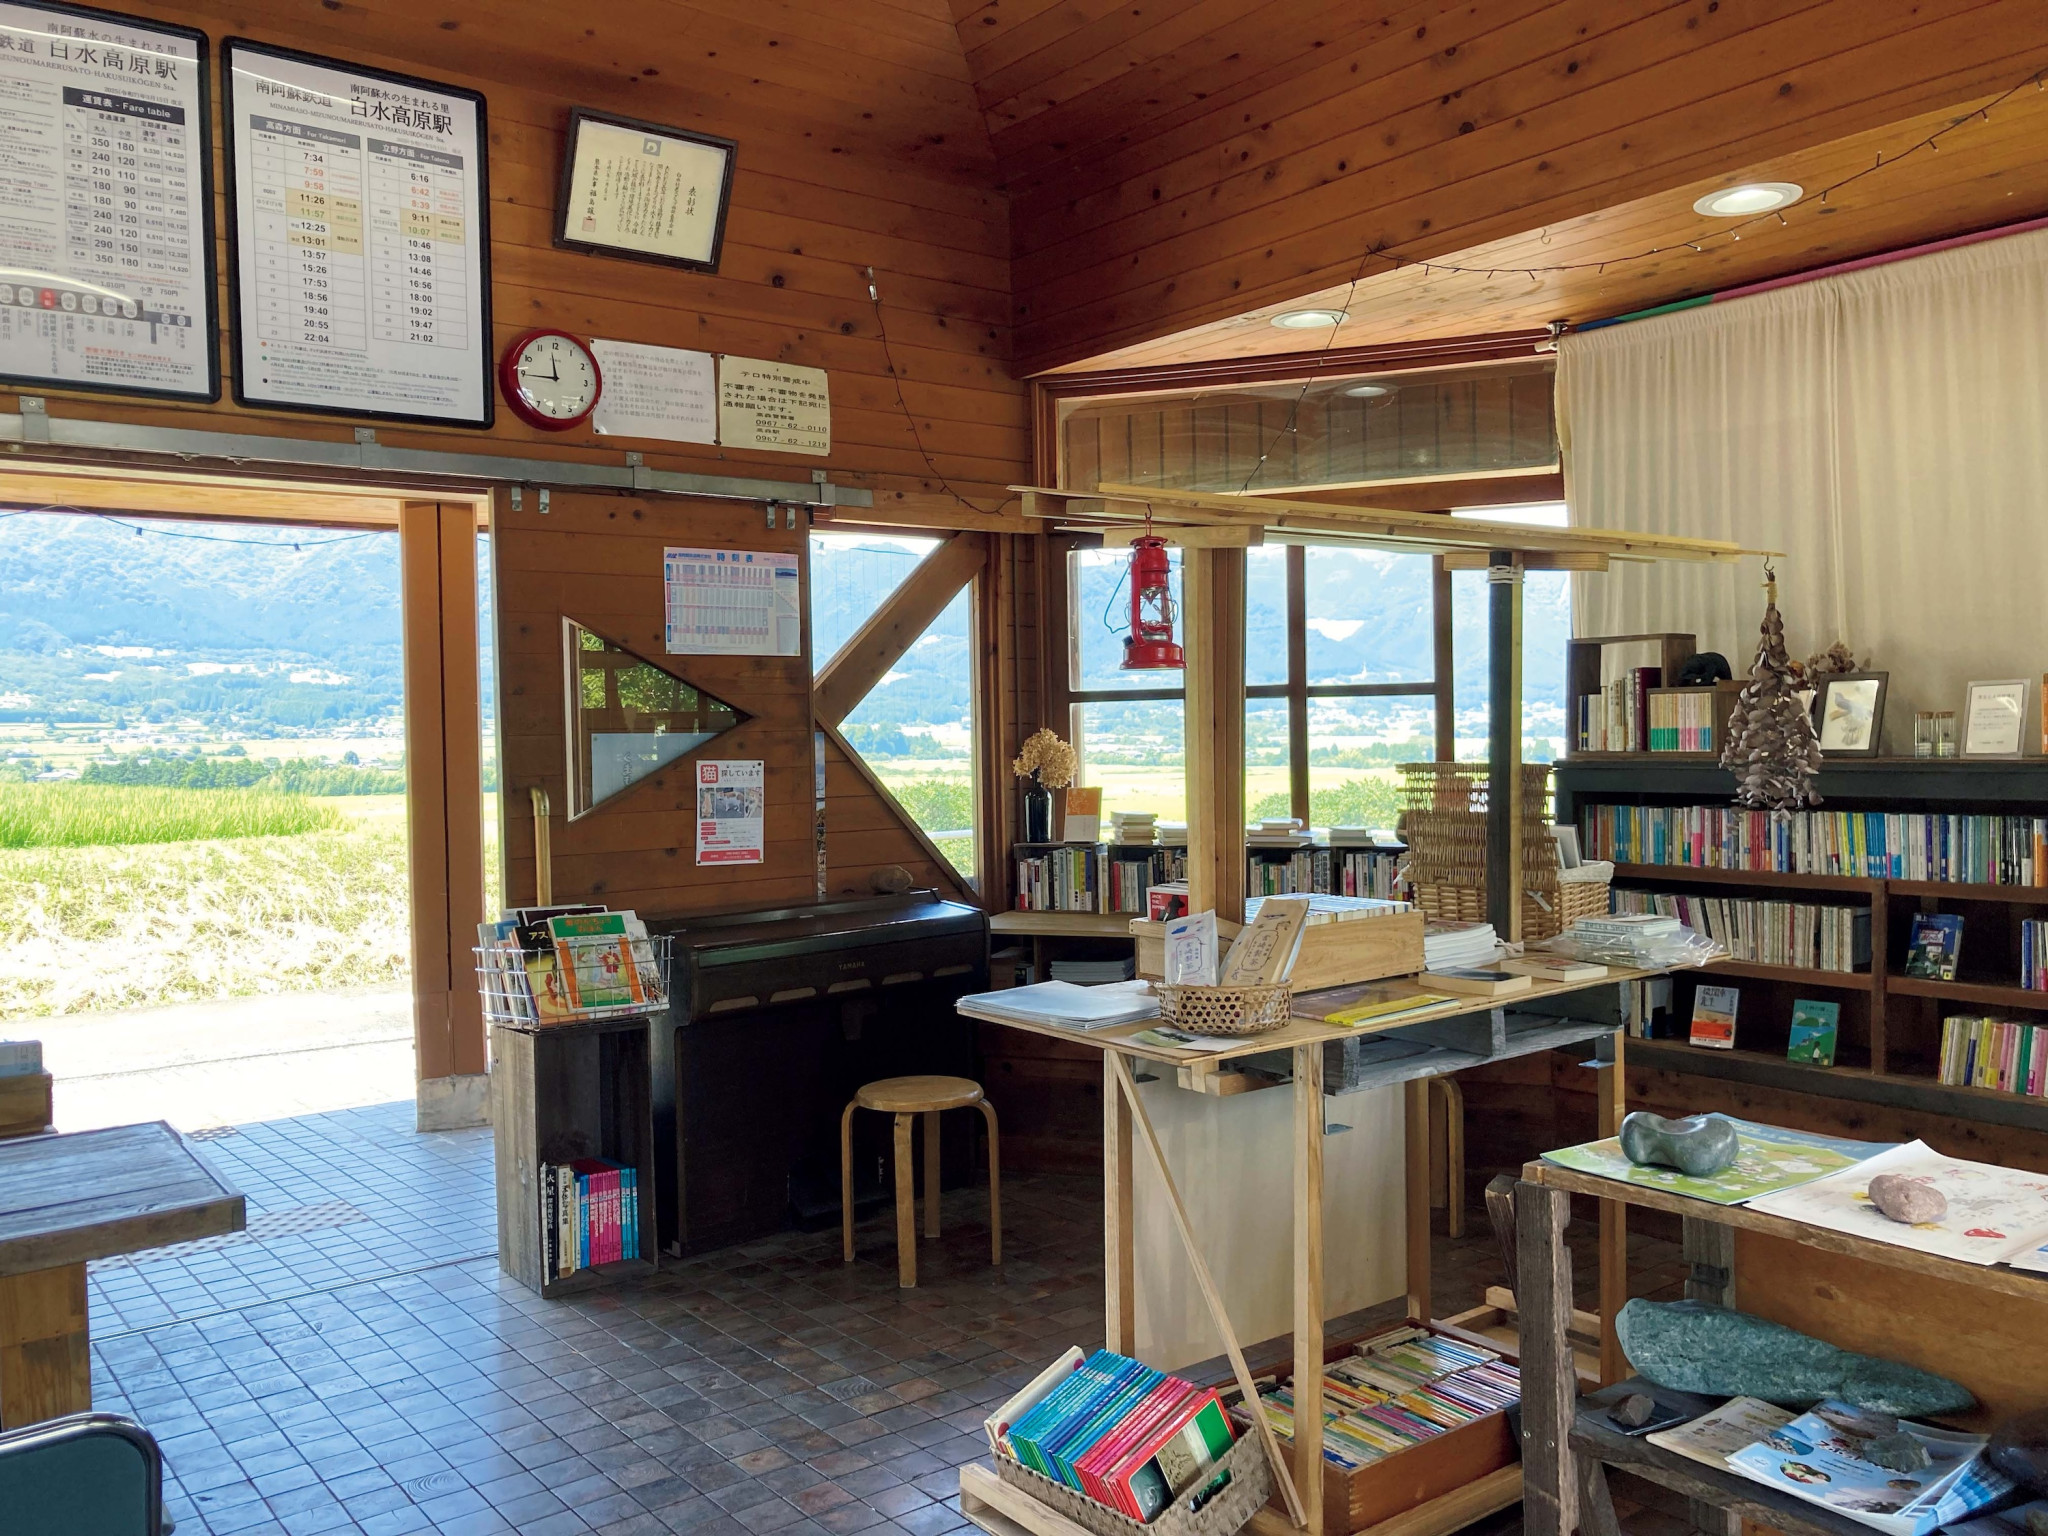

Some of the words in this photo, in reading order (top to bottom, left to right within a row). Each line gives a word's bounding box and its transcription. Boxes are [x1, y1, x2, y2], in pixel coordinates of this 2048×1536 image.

[51, 39, 177, 80] 白水高原駅
[256, 79, 333, 107] 南阿蘇鉄道
[350, 83, 450, 114] 南阿蘇水の生まれる里
[82, 94, 112, 108] 運賃表
[122, 102, 145, 113] Fare
[147, 106, 171, 118] table
[351, 96, 453, 135] 白水高原駅
[266, 121, 301, 135] 高森方面
[319, 133, 346, 143] Takamori
[91, 137, 110, 148] 350
[118, 142, 134, 152] 180
[382, 144, 415, 158] 立野方面
[91, 152, 110, 162] 240
[118, 156, 135, 166] 120
[303, 152, 323, 163] 7:34
[92, 166, 111, 177] 210
[118, 171, 136, 181] 110
[304, 166, 324, 177] 7:59
[410, 173, 429, 183] 6:16
[93, 181, 111, 191] 180
[123, 185, 136, 195] 90
[304, 180, 324, 191] 9:58
[411, 186, 430, 197] 6:42
[94, 195, 111, 206] 180
[300, 193, 325, 205] 11:26
[411, 199, 430, 210] 8:39
[685, 186, 696, 216] 表彰状
[124, 200, 136, 210] 90
[93, 210, 112, 220] 240
[300, 207, 325, 218] 11:57
[411, 213, 430, 223] 9:11
[120, 214, 137, 224] 120
[94, 225, 112, 235] 240
[301, 221, 326, 233] 12:25
[408, 226, 431, 236] 10:07
[120, 229, 137, 238] 120
[94, 239, 113, 249] 290
[301, 235, 325, 247] 13:01
[408, 239, 431, 250] 10:46
[120, 243, 138, 253] 150
[95, 254, 113, 264] 350
[302, 249, 326, 260] 13:57
[408, 253, 431, 263] 13:08
[121, 258, 139, 267] 180
[302, 263, 327, 274] 15:26
[409, 266, 432, 276] 14:46
[302, 277, 328, 288] 17:53
[409, 280, 432, 290] 16:56
[303, 291, 328, 302] 18:56
[410, 293, 432, 303] 18:00
[304, 305, 328, 316] 19:40
[410, 306, 433, 316] 19:02
[304, 319, 329, 330] 20:55
[410, 320, 433, 329] 19:47
[304, 333, 329, 343] 22:04
[410, 333, 433, 343] 21:02
[537, 344, 543, 352] 11
[552, 342, 559, 350] 12
[740, 371, 811, 385] テロ特別警戒中
[723, 382, 827, 400] 不審者・不審物を発見
[724, 392, 827, 409] された場合は下記宛に
[723, 400, 792, 413] 通報願います。
[716, 552, 754, 563] 時刻表
[702, 766, 717, 781] 猫
[721, 769, 761, 778] 探しています
[528, 931, 550, 941] アス
[838, 961, 865, 971] YAMAHA
[546, 1174, 555, 1196] 火星
